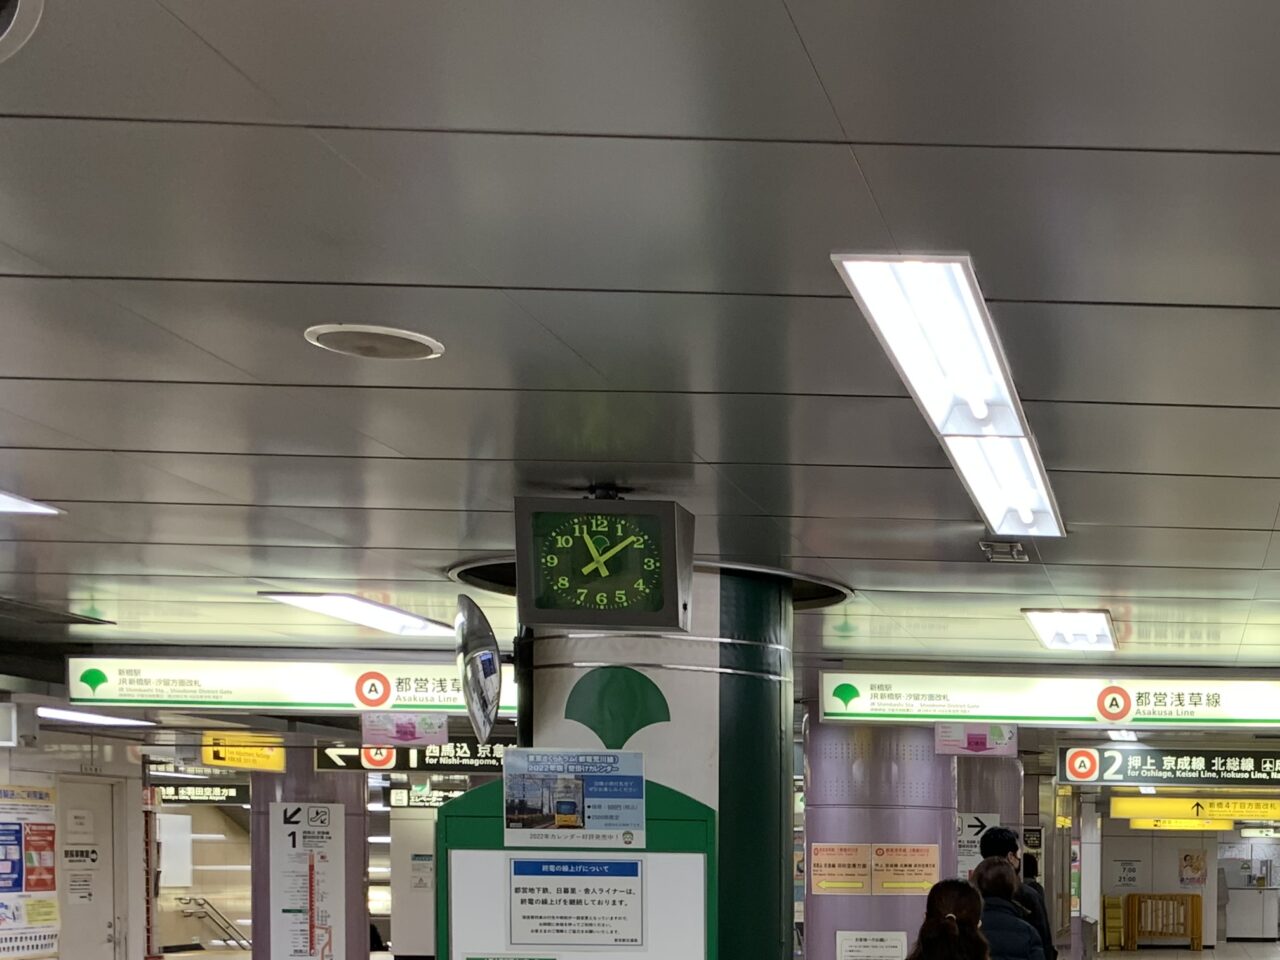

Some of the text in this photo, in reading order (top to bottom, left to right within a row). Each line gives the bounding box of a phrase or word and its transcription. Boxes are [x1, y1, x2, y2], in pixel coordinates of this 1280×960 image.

[573, 524, 588, 536] 11
[590, 519, 608, 532] 12
[616, 524, 623, 536] 1
[556, 536, 573, 548] 10
[633, 537, 644, 548] 2
[547, 555, 558, 566] 9
[644, 558, 655, 570] 3
[558, 576, 570, 588] 8
[634, 578, 645, 590] 4
[576, 589, 588, 602] 7
[596, 593, 608, 605] 6
[615, 590, 626, 602] 5
[368, 684, 378, 694] A
[396, 695, 435, 703] Asakusa
[1109, 697, 1120, 708] A
[1136, 692, 1220, 708] 都営浅草線
[426, 743, 470, 757] 西馬込
[440, 757, 498, 766] Nishi-magome,
[1078, 750, 1123, 780] A 2
[1128, 756, 1156, 769] 押上
[1162, 756, 1206, 771] 京成線
[1211, 757, 1254, 772] 北総線
[1141, 770, 1174, 778] Oshiage,
[1201, 770, 1219, 779] Line,
[1251, 772, 1270, 780] Line,
[288, 831, 296, 848] 1
